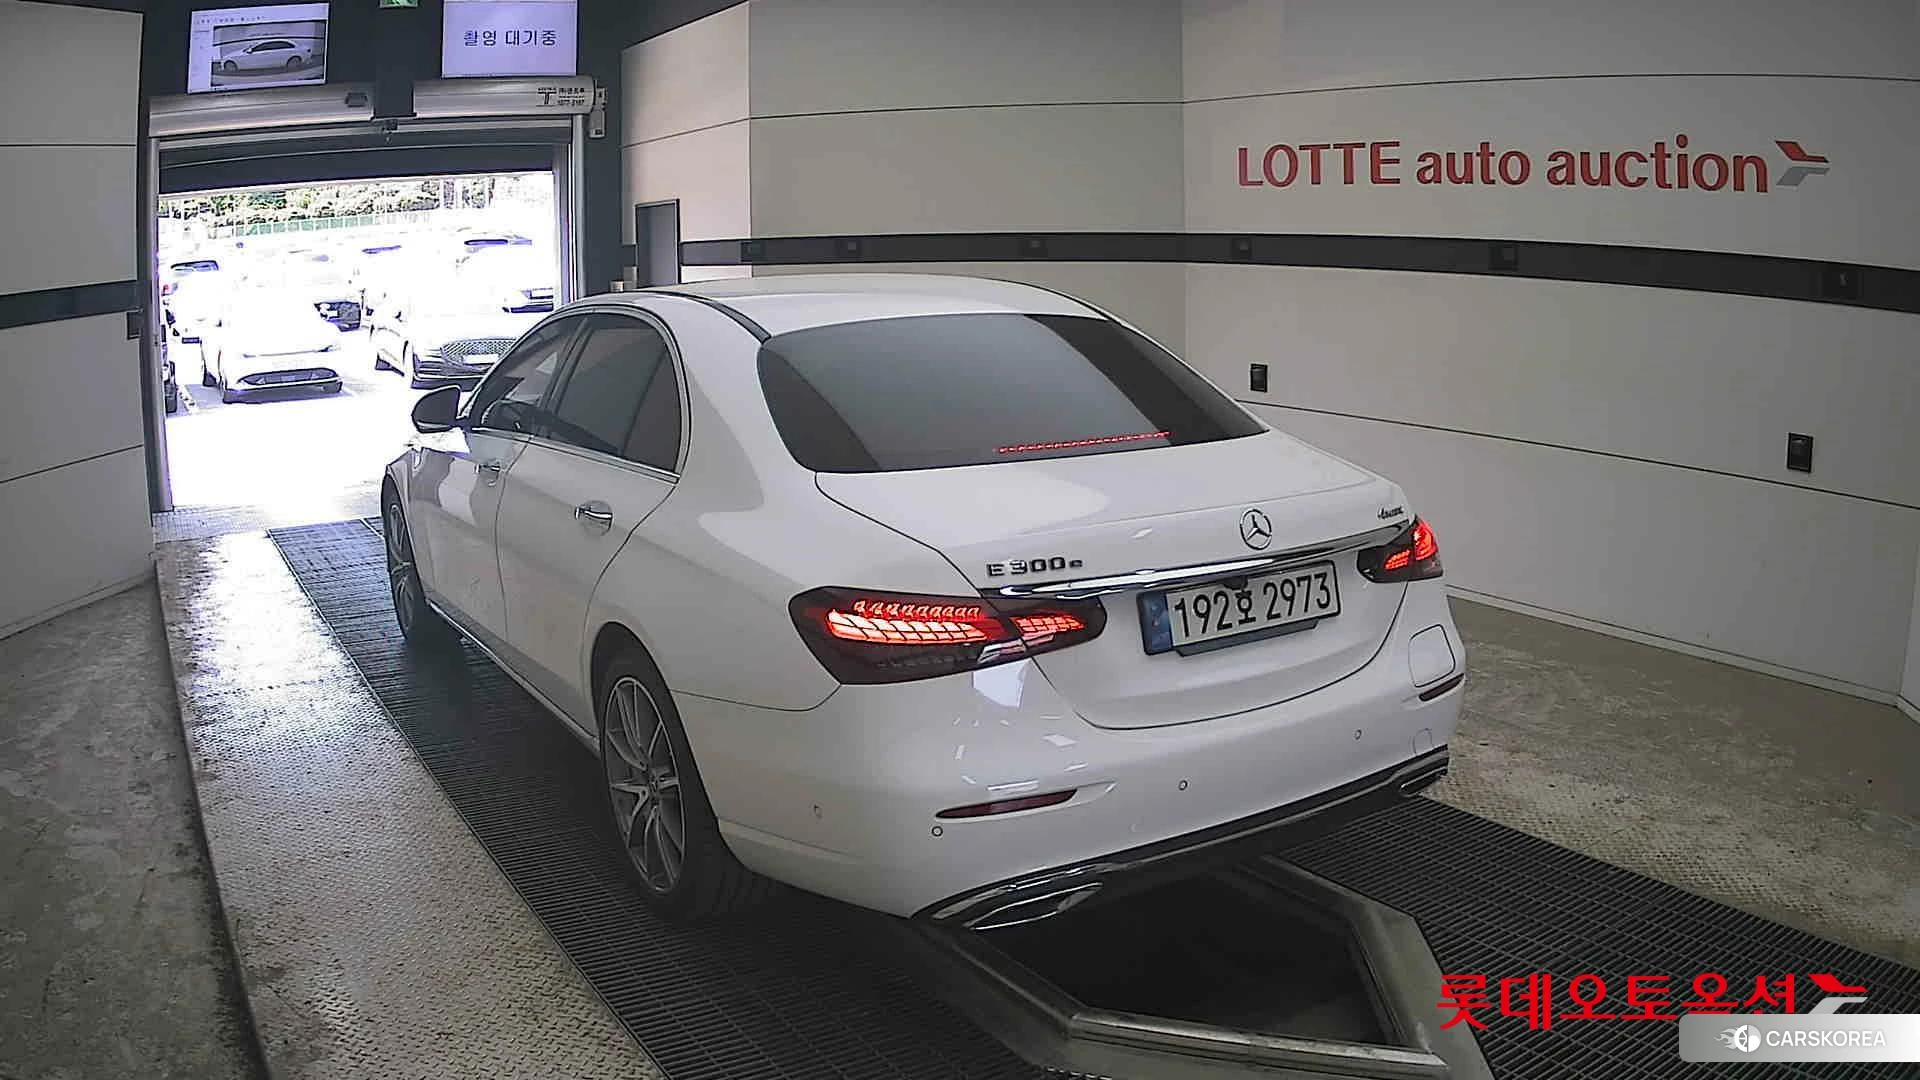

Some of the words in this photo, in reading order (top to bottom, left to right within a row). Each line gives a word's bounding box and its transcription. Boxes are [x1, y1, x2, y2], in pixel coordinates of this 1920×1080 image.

[505, 30, 557, 46] 대기중
[1237, 140, 1400, 188] LOTTE
[1416, 141, 1531, 186] auto
[1546, 134, 1769, 193] auction
[986, 563, 1005, 577] E
[1173, 590, 1257, 639] 192호
[1263, 571, 1331, 621] 2973
